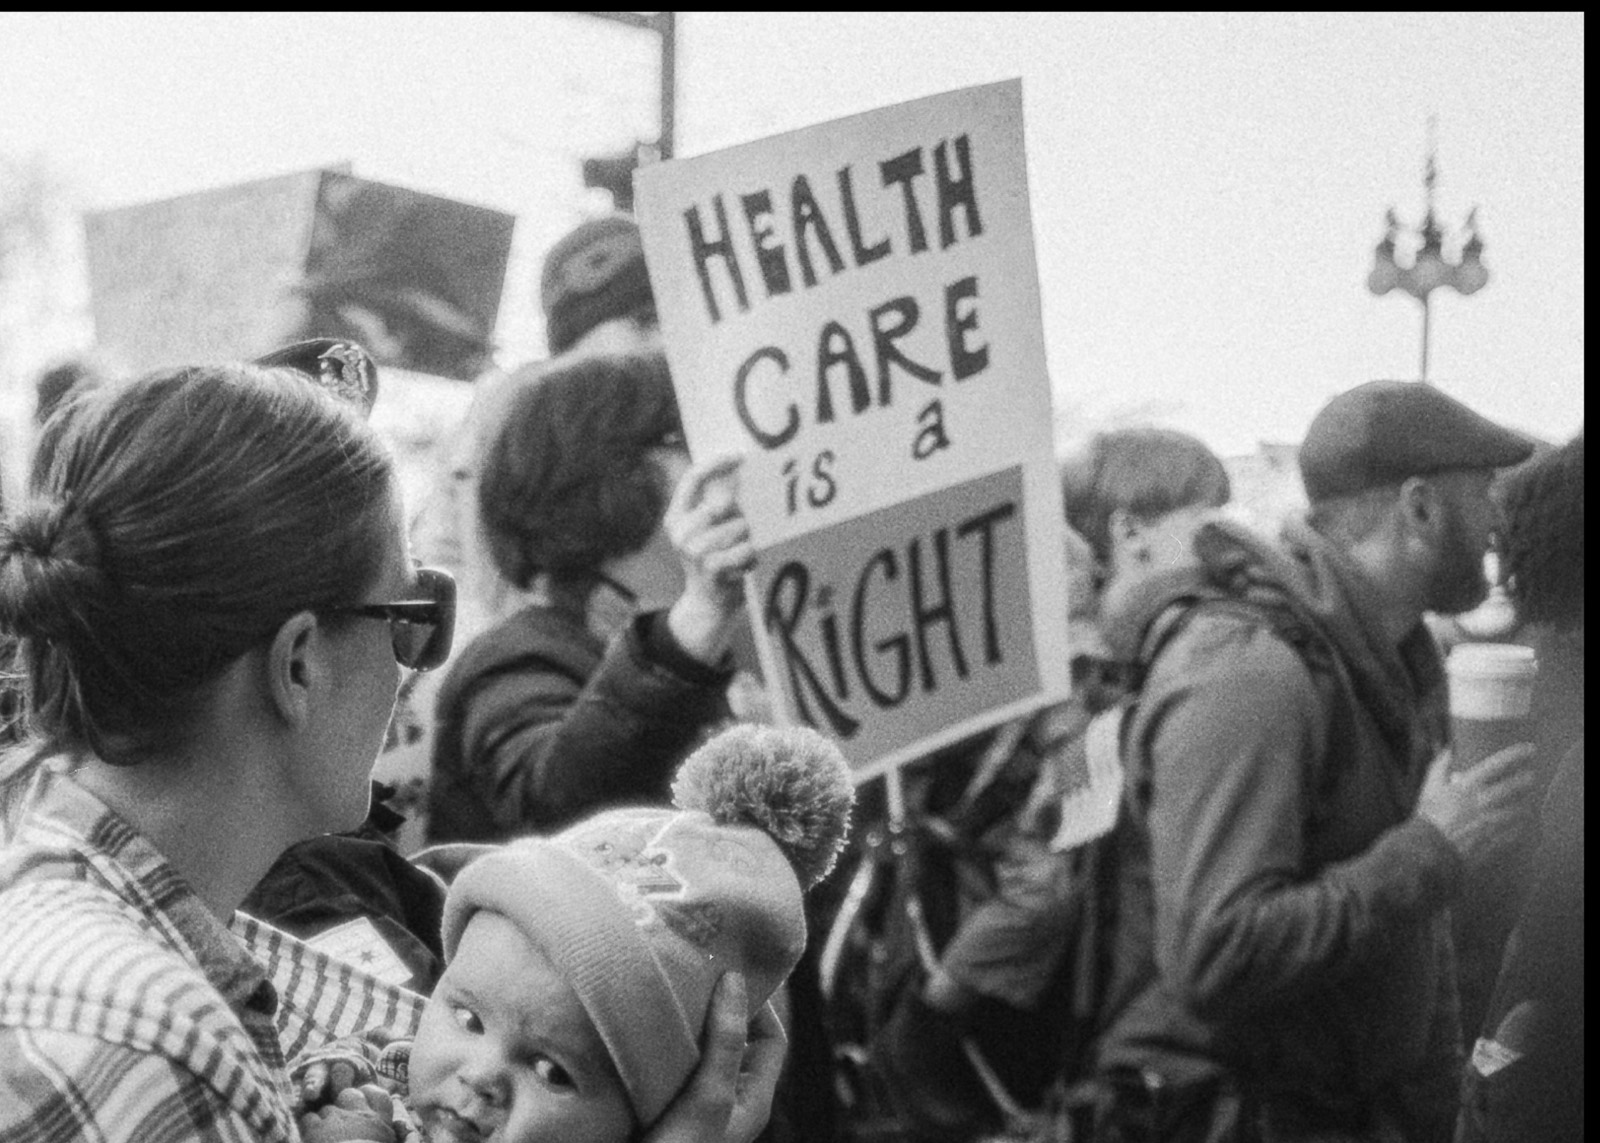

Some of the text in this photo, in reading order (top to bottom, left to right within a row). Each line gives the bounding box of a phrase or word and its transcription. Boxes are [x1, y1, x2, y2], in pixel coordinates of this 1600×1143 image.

[683, 134, 983, 323] HEALTH
[733, 275, 990, 449] CARE
[781, 397, 952, 517] is a
